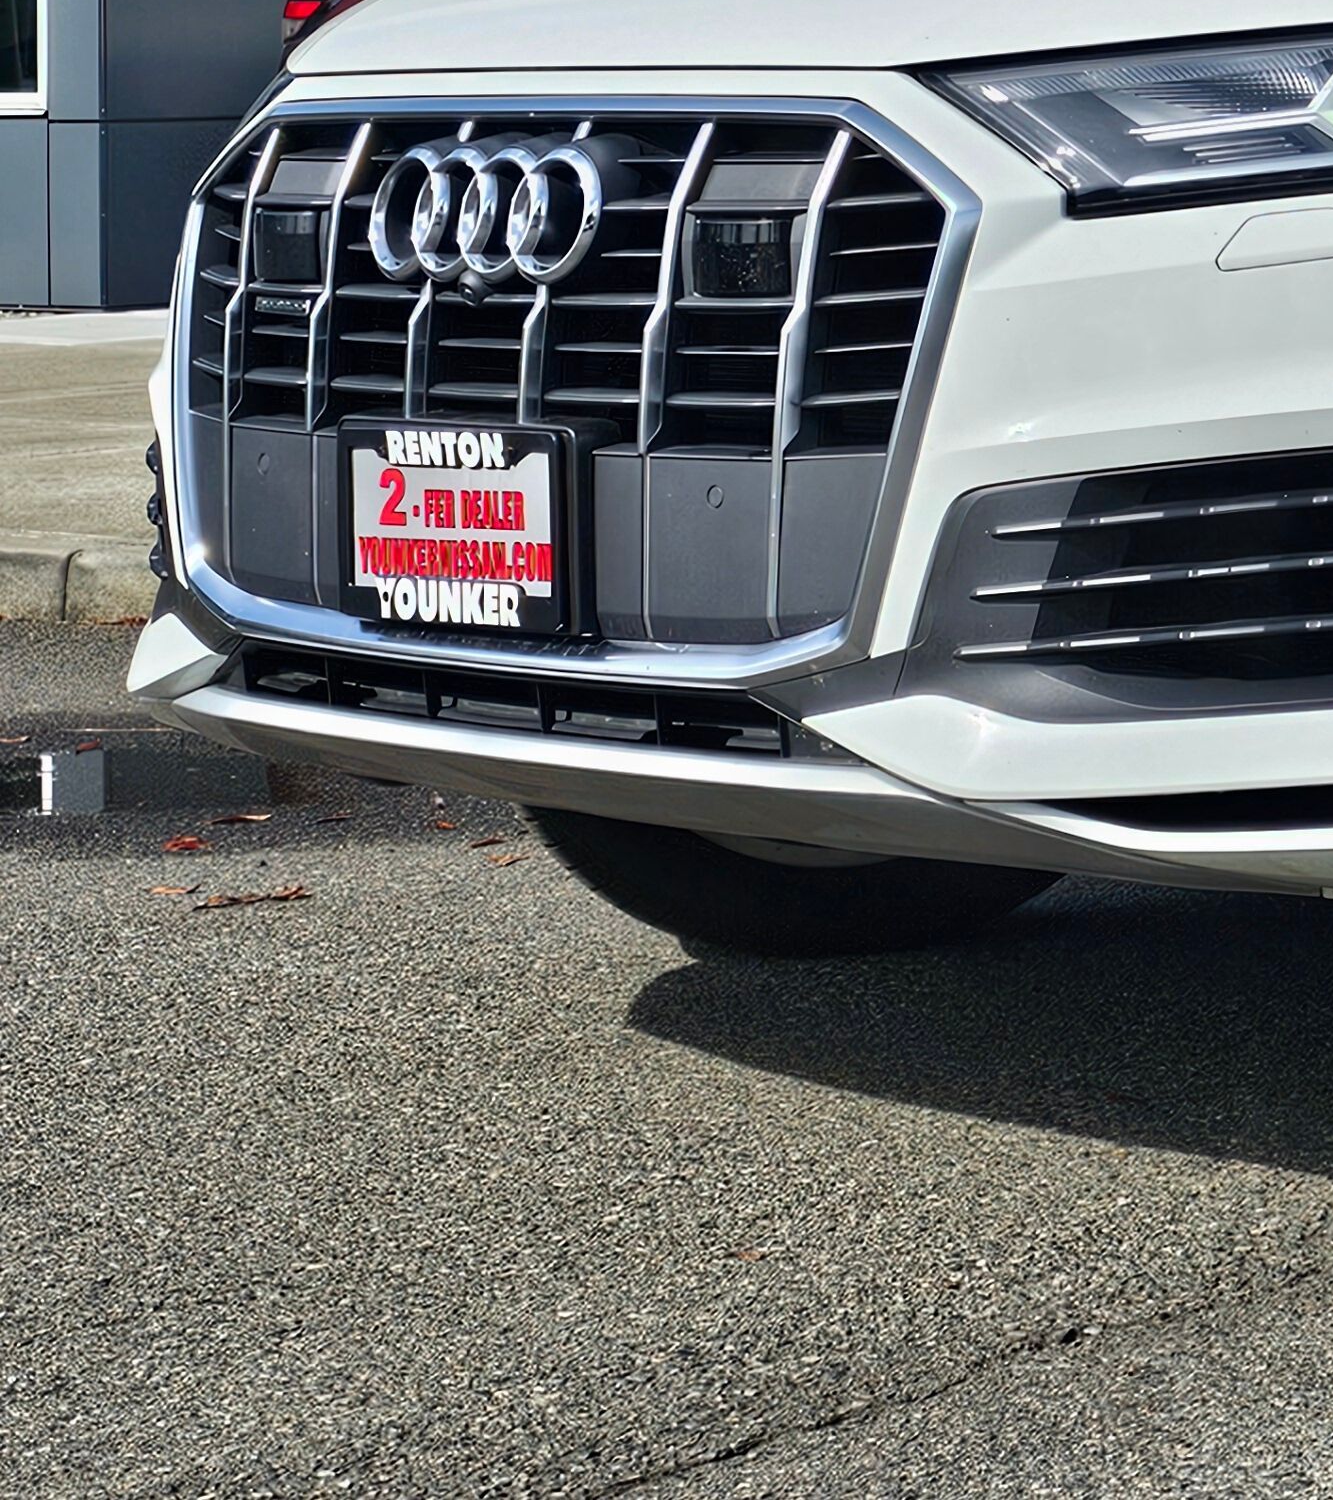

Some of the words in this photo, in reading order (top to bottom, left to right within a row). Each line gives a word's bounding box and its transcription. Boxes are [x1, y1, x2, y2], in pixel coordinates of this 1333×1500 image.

[385, 430, 506, 469] RENTON
[460, 489, 526, 531] DEALER
[358, 536, 552, 582] YOUNKERNISSAN.COM
[374, 576, 521, 627] YOUNKER
